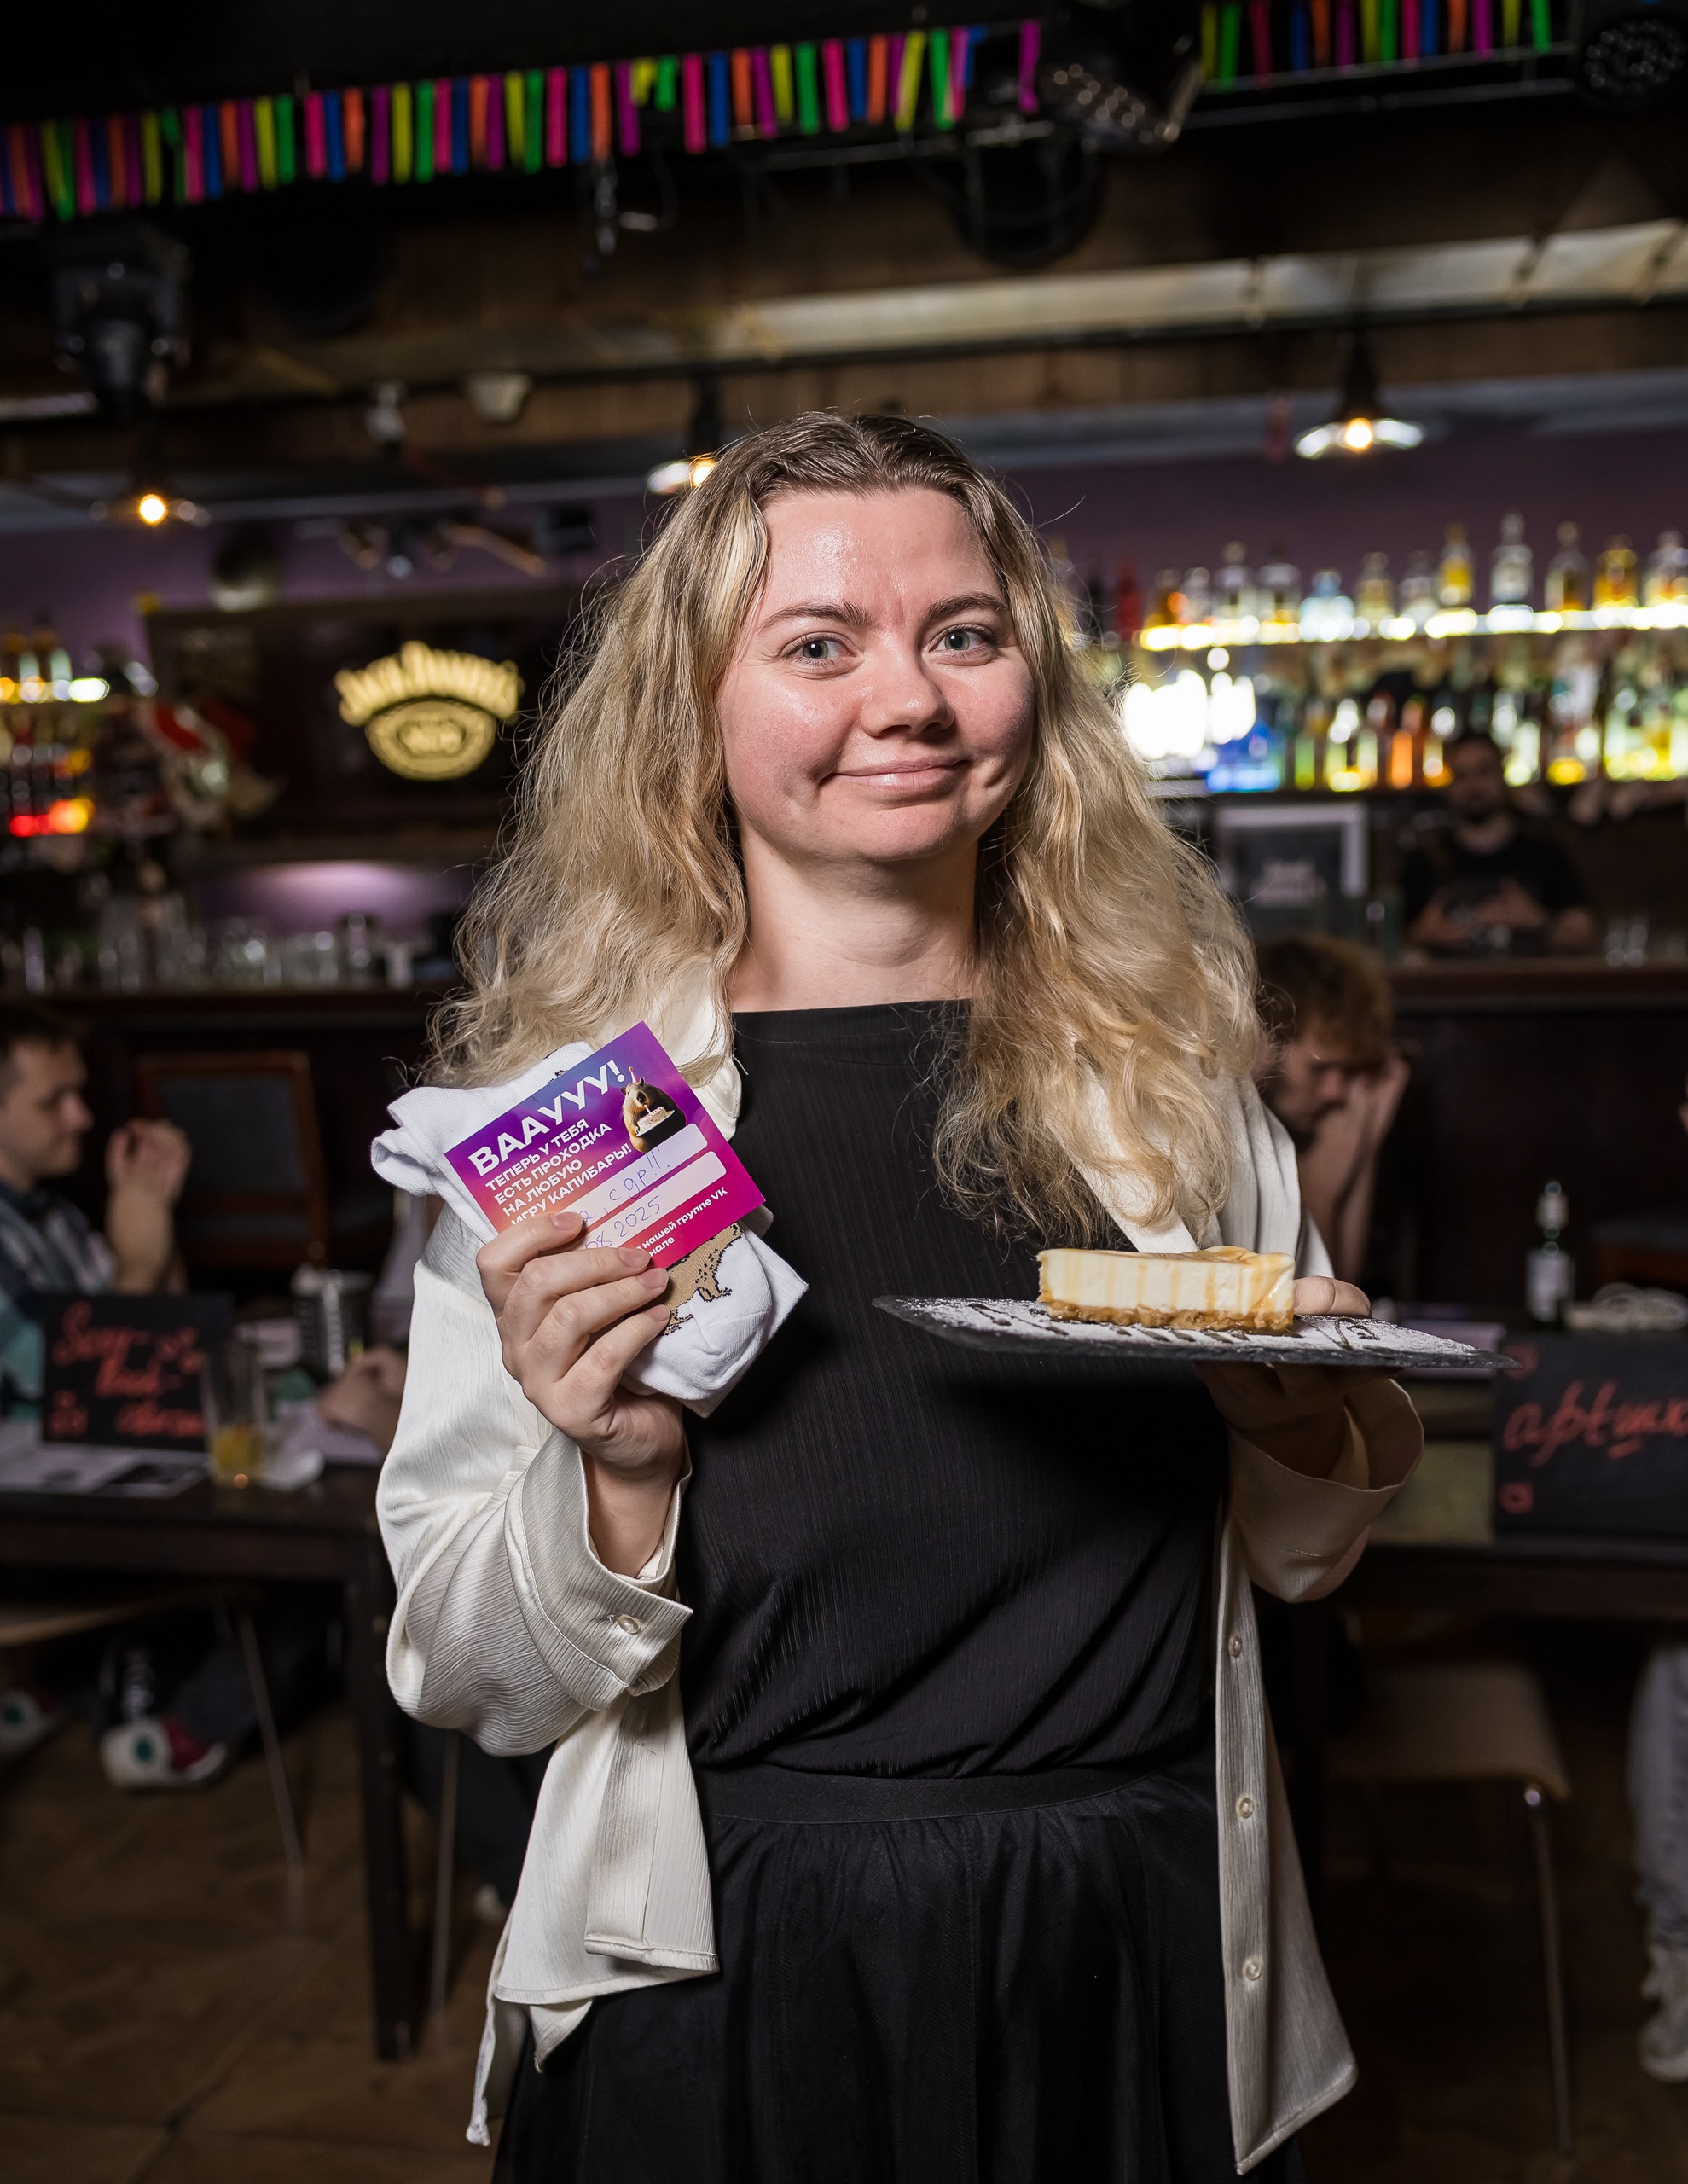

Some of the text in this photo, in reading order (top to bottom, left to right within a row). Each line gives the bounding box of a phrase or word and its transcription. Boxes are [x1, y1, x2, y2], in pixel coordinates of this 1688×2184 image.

[468, 1060, 625, 1176] ВААУУУ!
[485, 1118, 589, 1191] ТЕПЕРЬ У ТЕБЯ
[494, 1123, 612, 1205] ЕСТЬ ПРОХОДКА
[502, 1159, 583, 1217] НА ЛЮБУЮ
[548, 1142, 632, 1204] КАПИБАРЫ!
[641, 1186, 728, 1249] нашей группе VK
